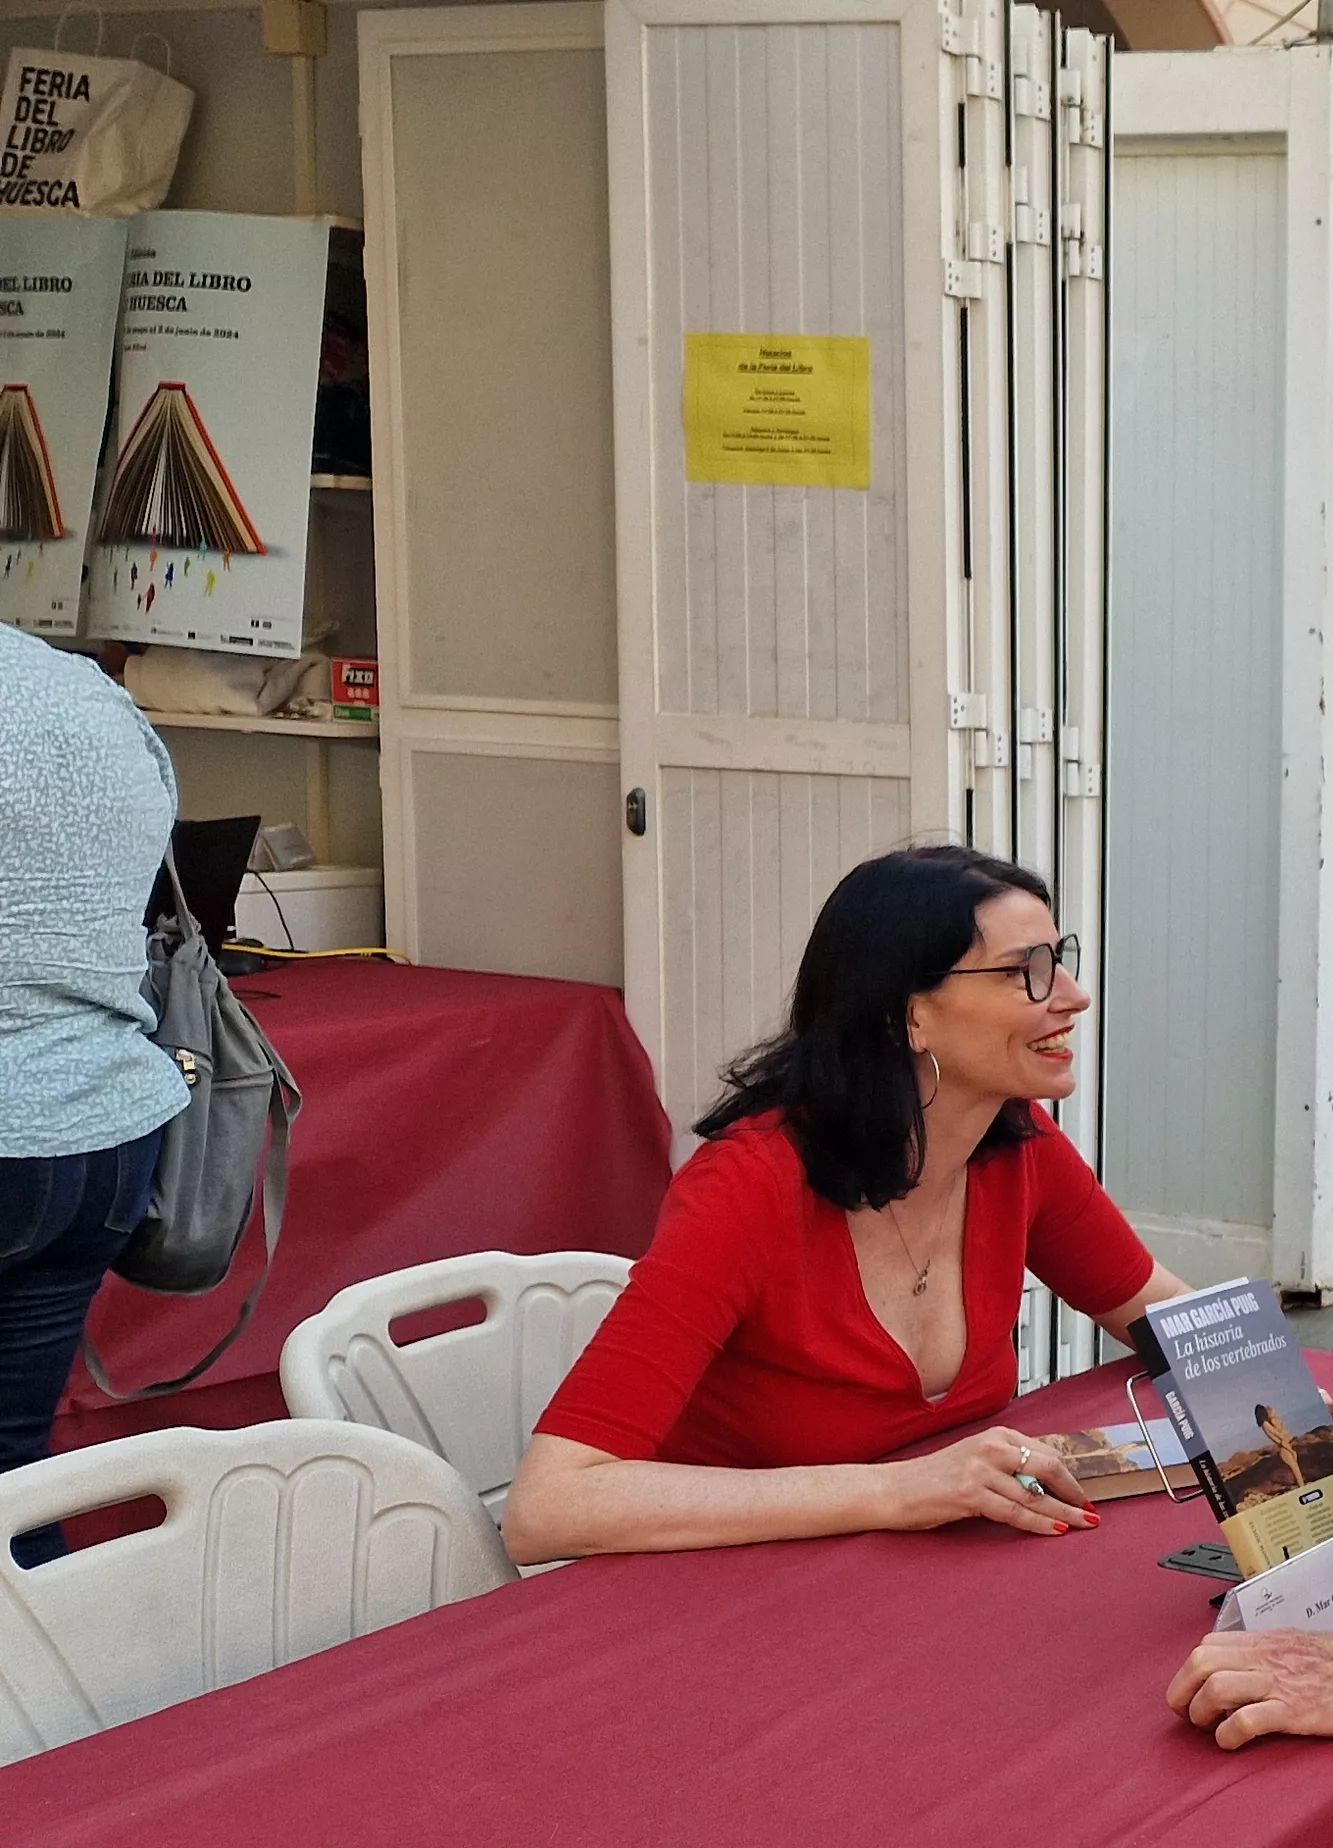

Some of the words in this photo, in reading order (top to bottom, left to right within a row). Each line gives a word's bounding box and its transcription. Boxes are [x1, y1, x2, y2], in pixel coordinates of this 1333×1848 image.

[20, 67, 90, 102] FERIA
[14, 96, 59, 127] DEL
[6, 124, 75, 154] LIBRO
[0, 152, 35, 179] DE
[23, 276, 72, 293] LIBRO
[152, 271, 185, 288] DEL
[189, 272, 252, 293] LIBRO
[129, 295, 188, 312] HUESCA
[1160, 1311, 1194, 1339] MAR
[1190, 1297, 1236, 1330] GARCÍA
[1231, 1292, 1260, 1318] PUIG
[1174, 1340, 1194, 1360] La
[1194, 1324, 1244, 1353] historia
[1184, 1360, 1201, 1380] de
[1201, 1353, 1221, 1374] los
[1223, 1333, 1288, 1366] vertebrados
[1165, 1390, 1186, 1423] GARCÍA
[1178, 1417, 1195, 1441] PUIG
[1305, 1607, 1316, 1619] D.
[1315, 1598, 1332, 1613] Mar
